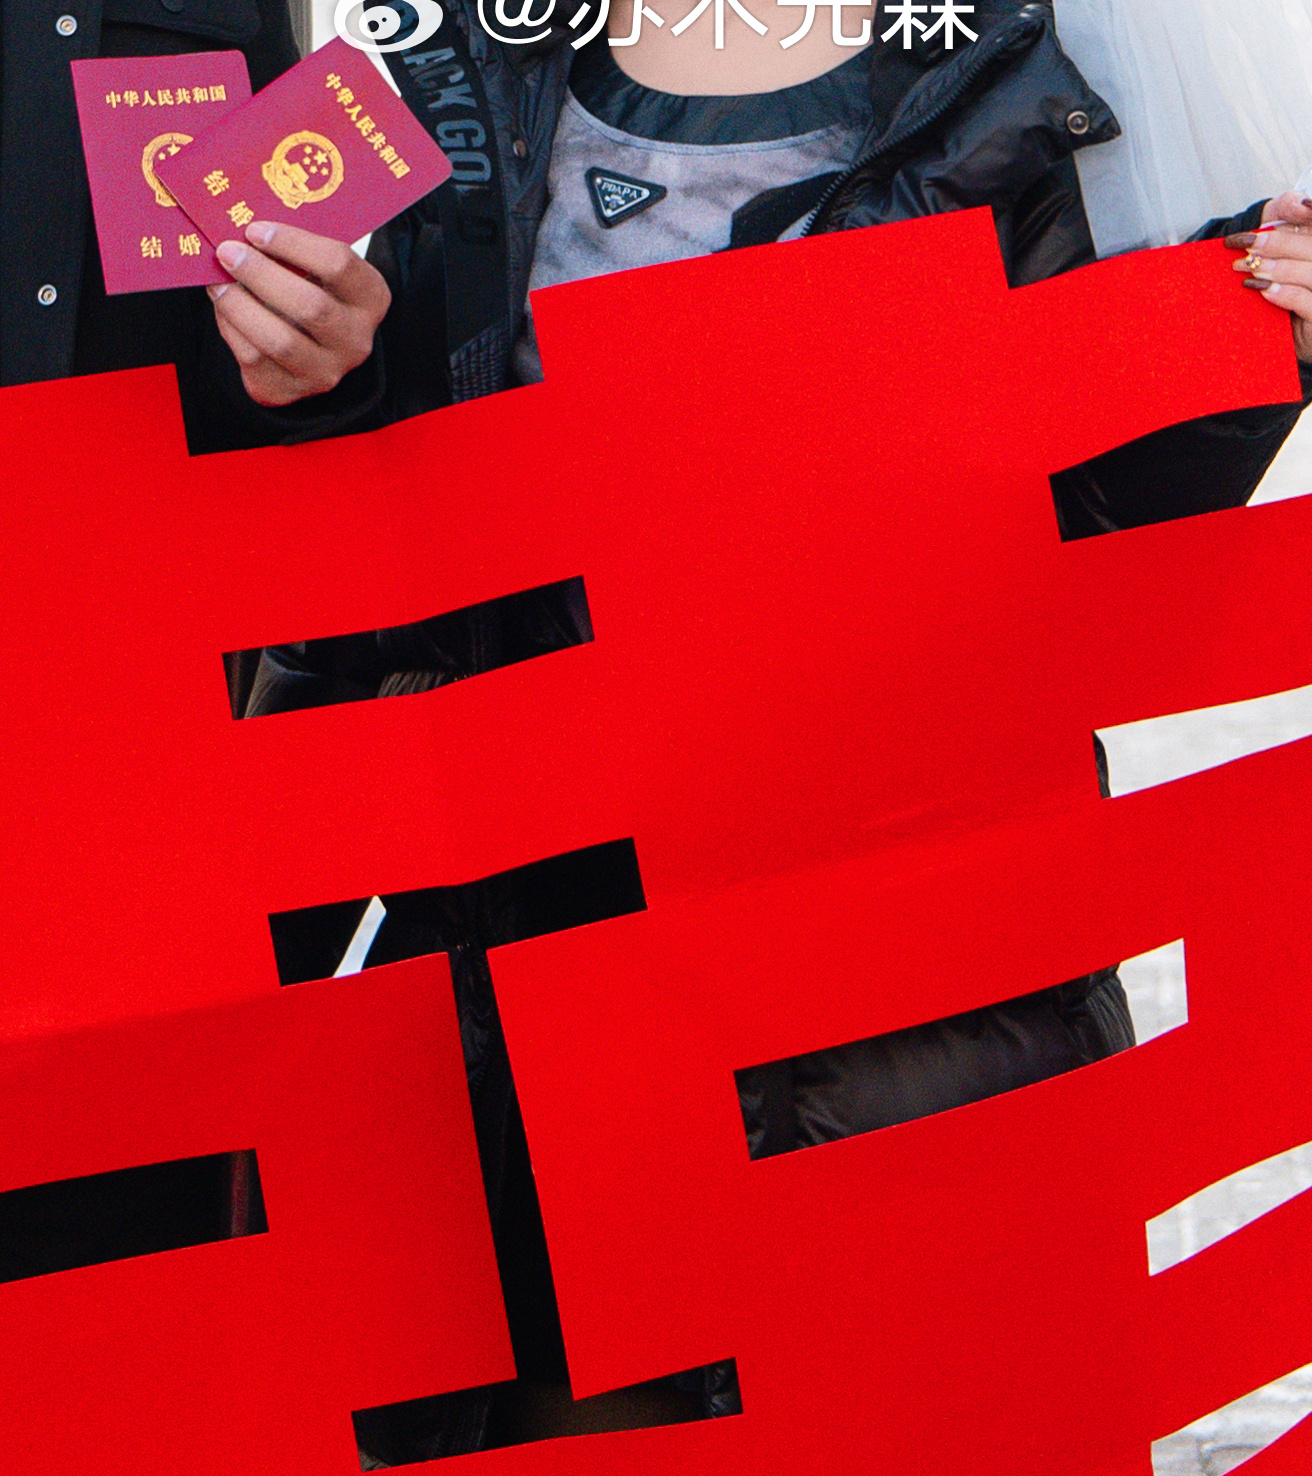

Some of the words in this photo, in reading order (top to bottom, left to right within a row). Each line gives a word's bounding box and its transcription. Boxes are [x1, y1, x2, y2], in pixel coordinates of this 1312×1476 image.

[106, 84, 226, 108] 中华人民共和国
[325, 73, 411, 179] 中华人民共和国
